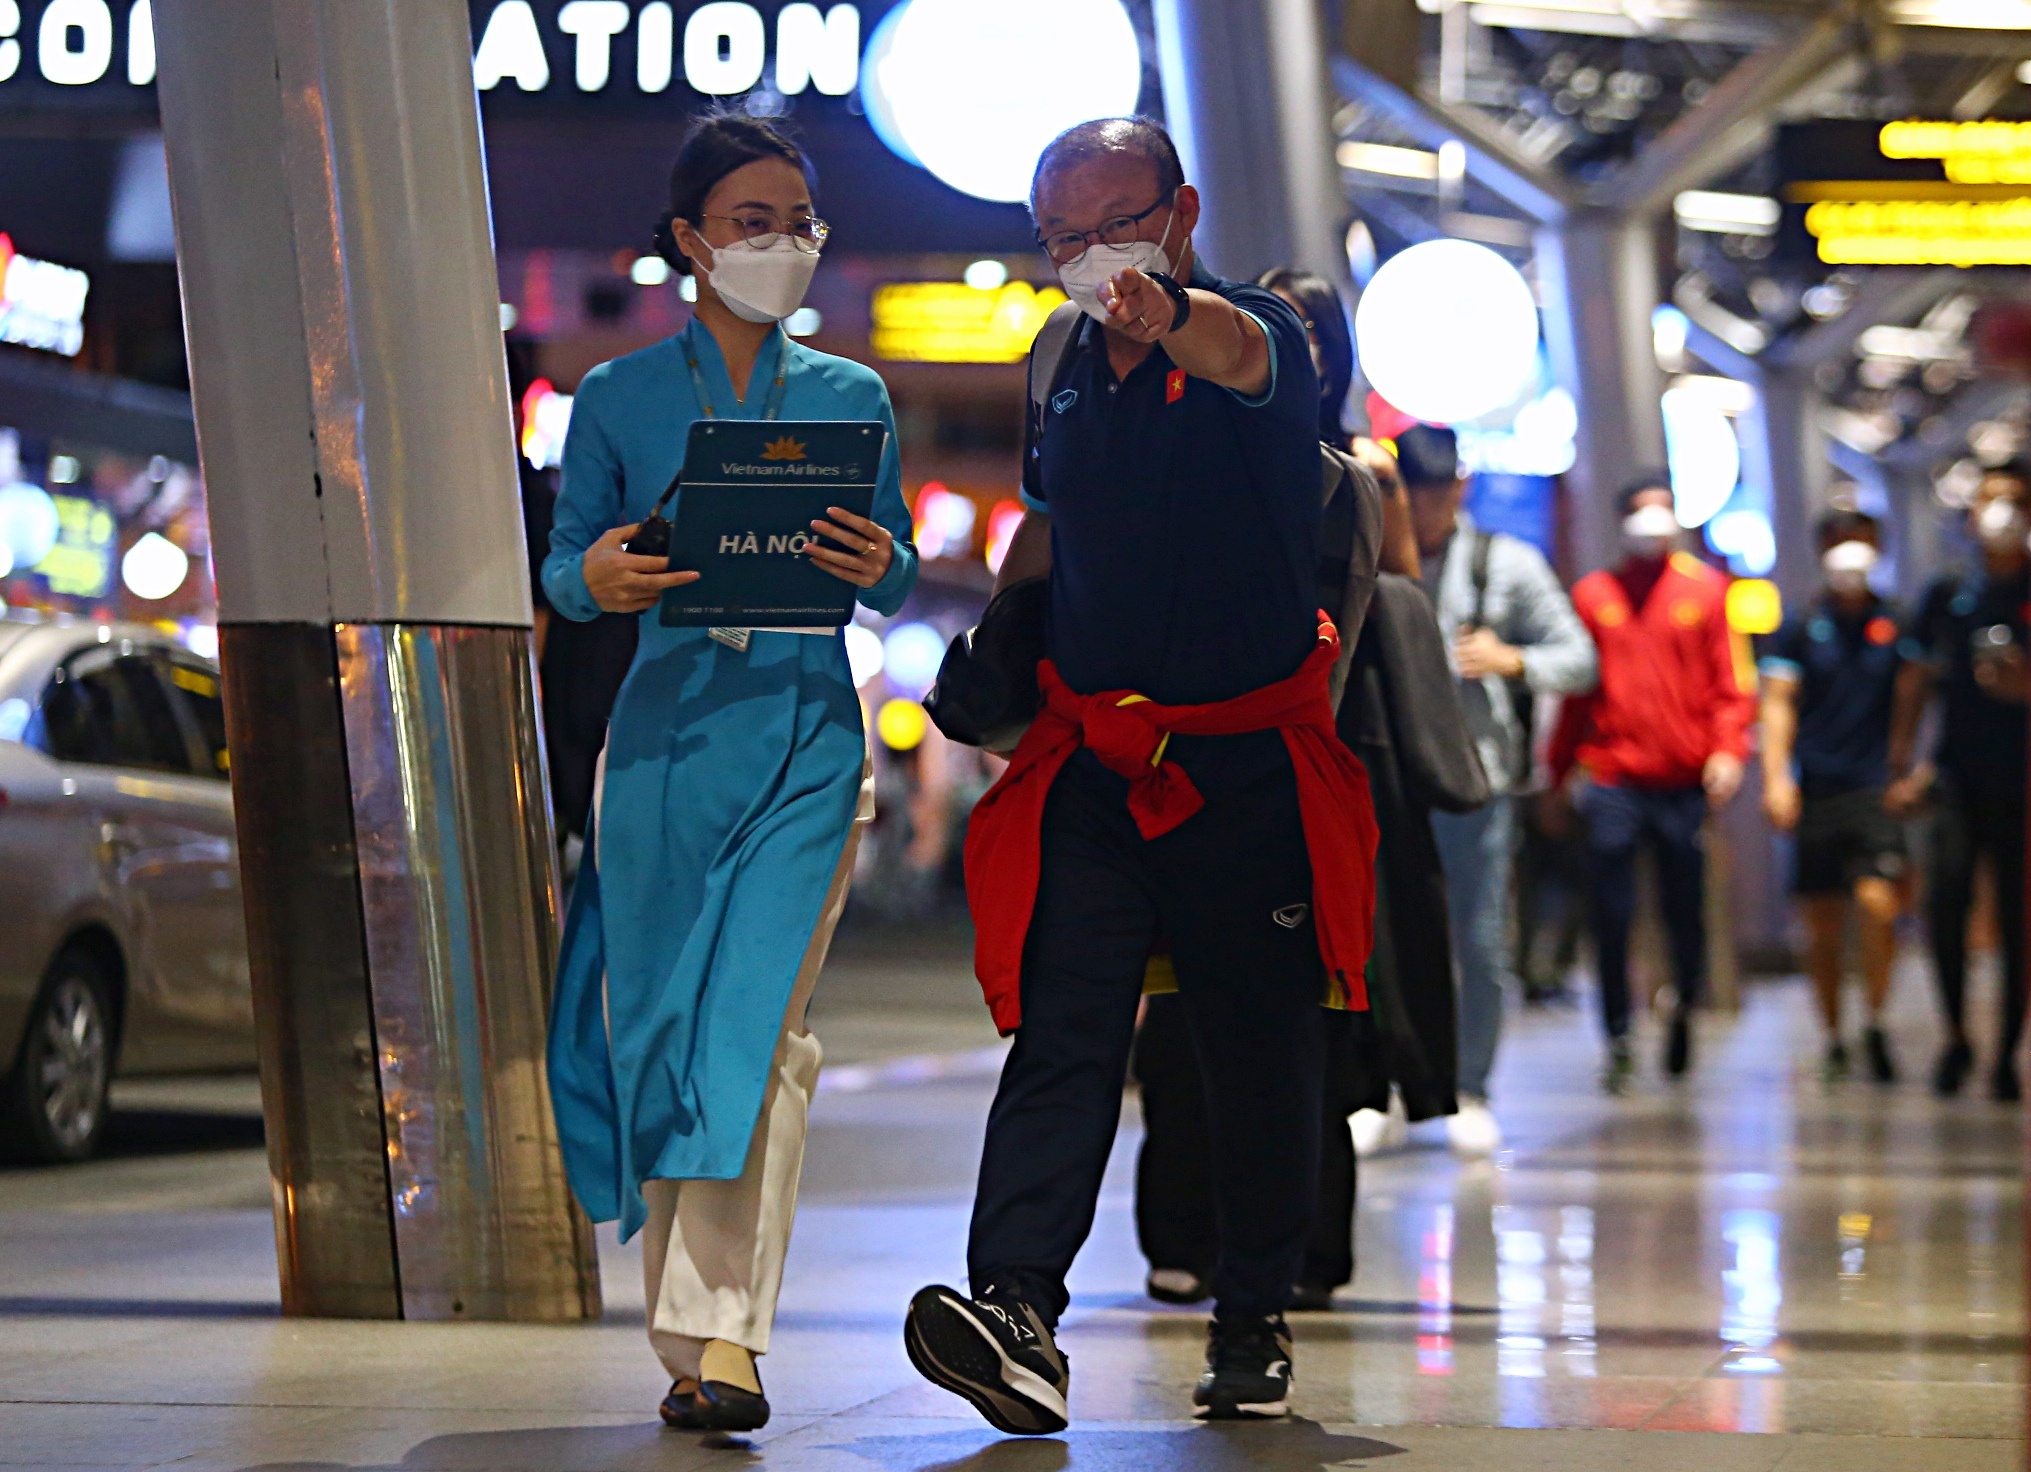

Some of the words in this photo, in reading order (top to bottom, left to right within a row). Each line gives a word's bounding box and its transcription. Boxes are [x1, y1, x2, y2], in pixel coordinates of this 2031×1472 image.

[721, 462, 783, 476] Vietnam
[785, 463, 840, 476] Airlines
[718, 530, 759, 554] HÀ
